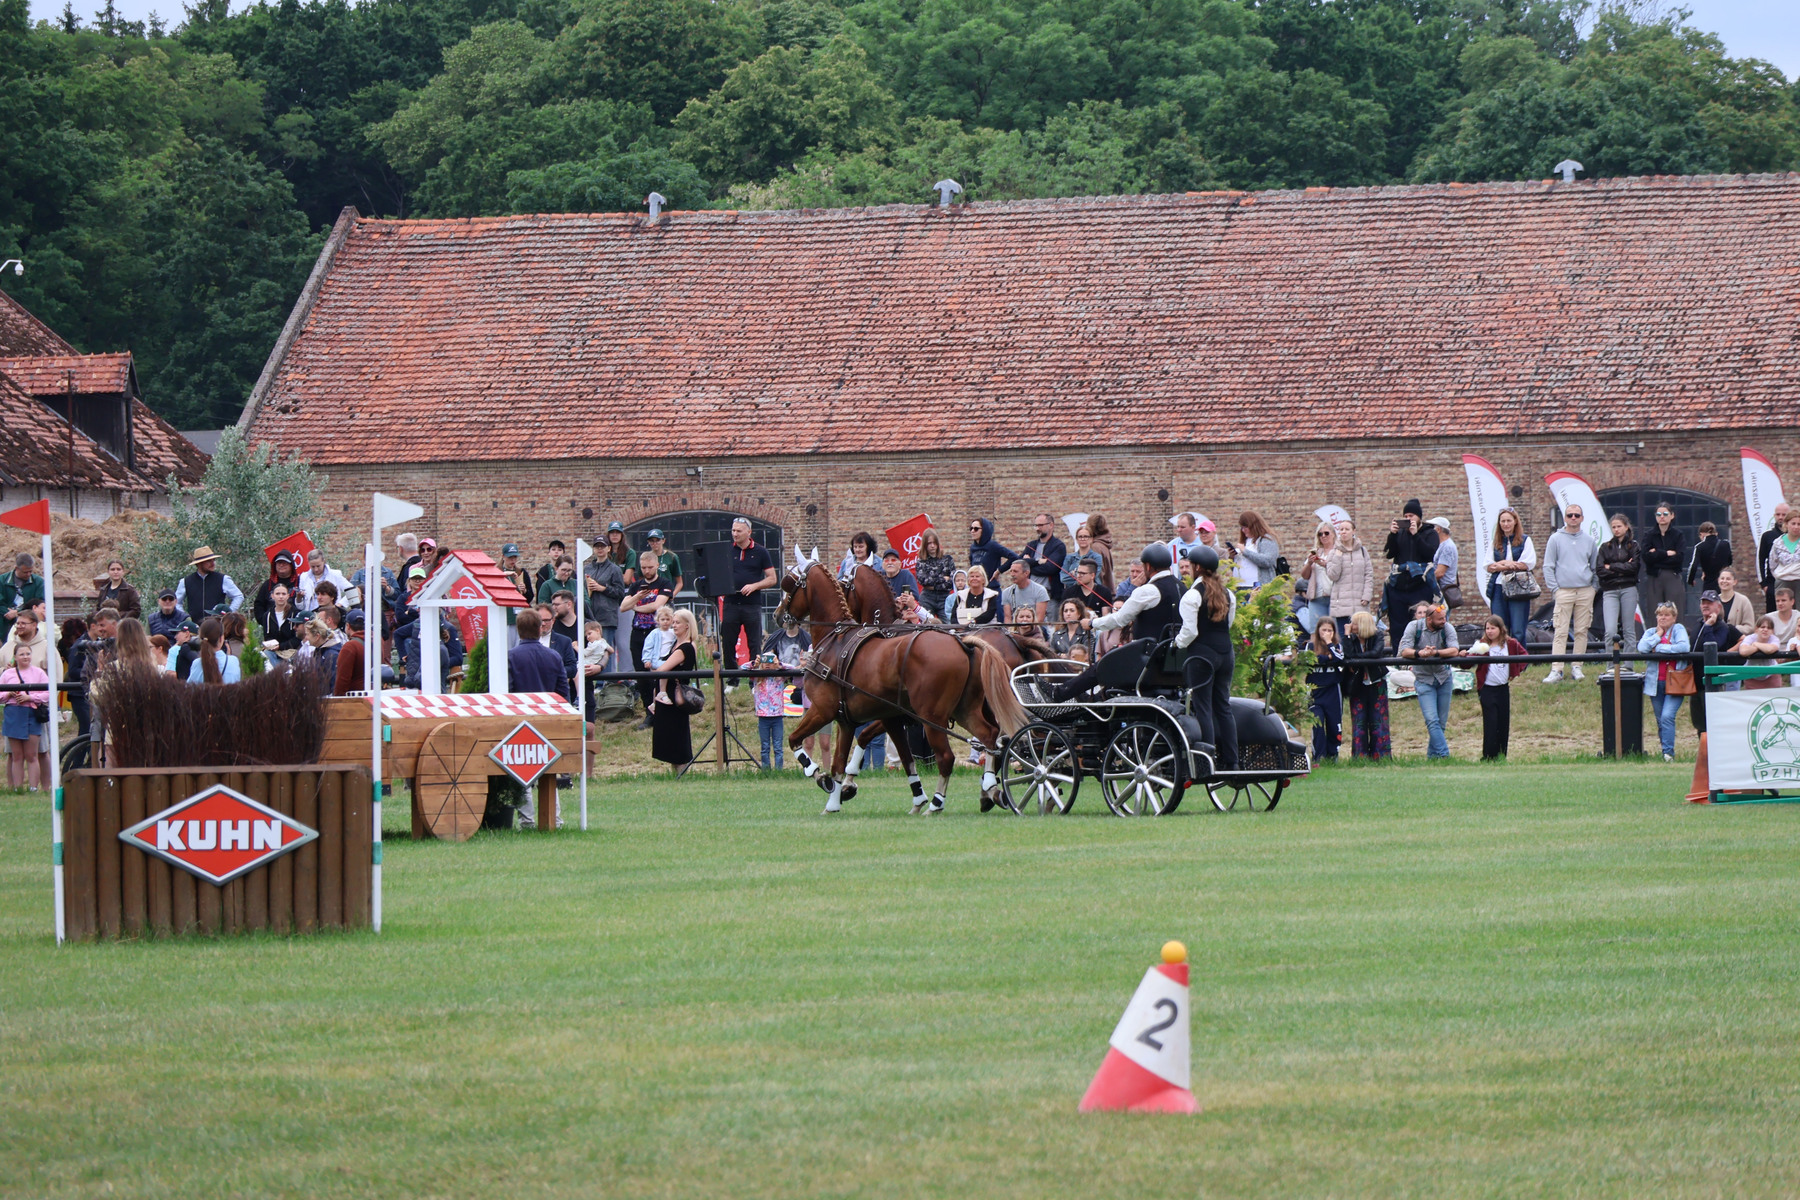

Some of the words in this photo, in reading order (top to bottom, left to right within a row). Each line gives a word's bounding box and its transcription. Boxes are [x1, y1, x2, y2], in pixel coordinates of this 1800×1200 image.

[502, 744, 549, 765] KUHN
[157, 819, 282, 850] KUHN
[1136, 998, 1178, 1051] 2
